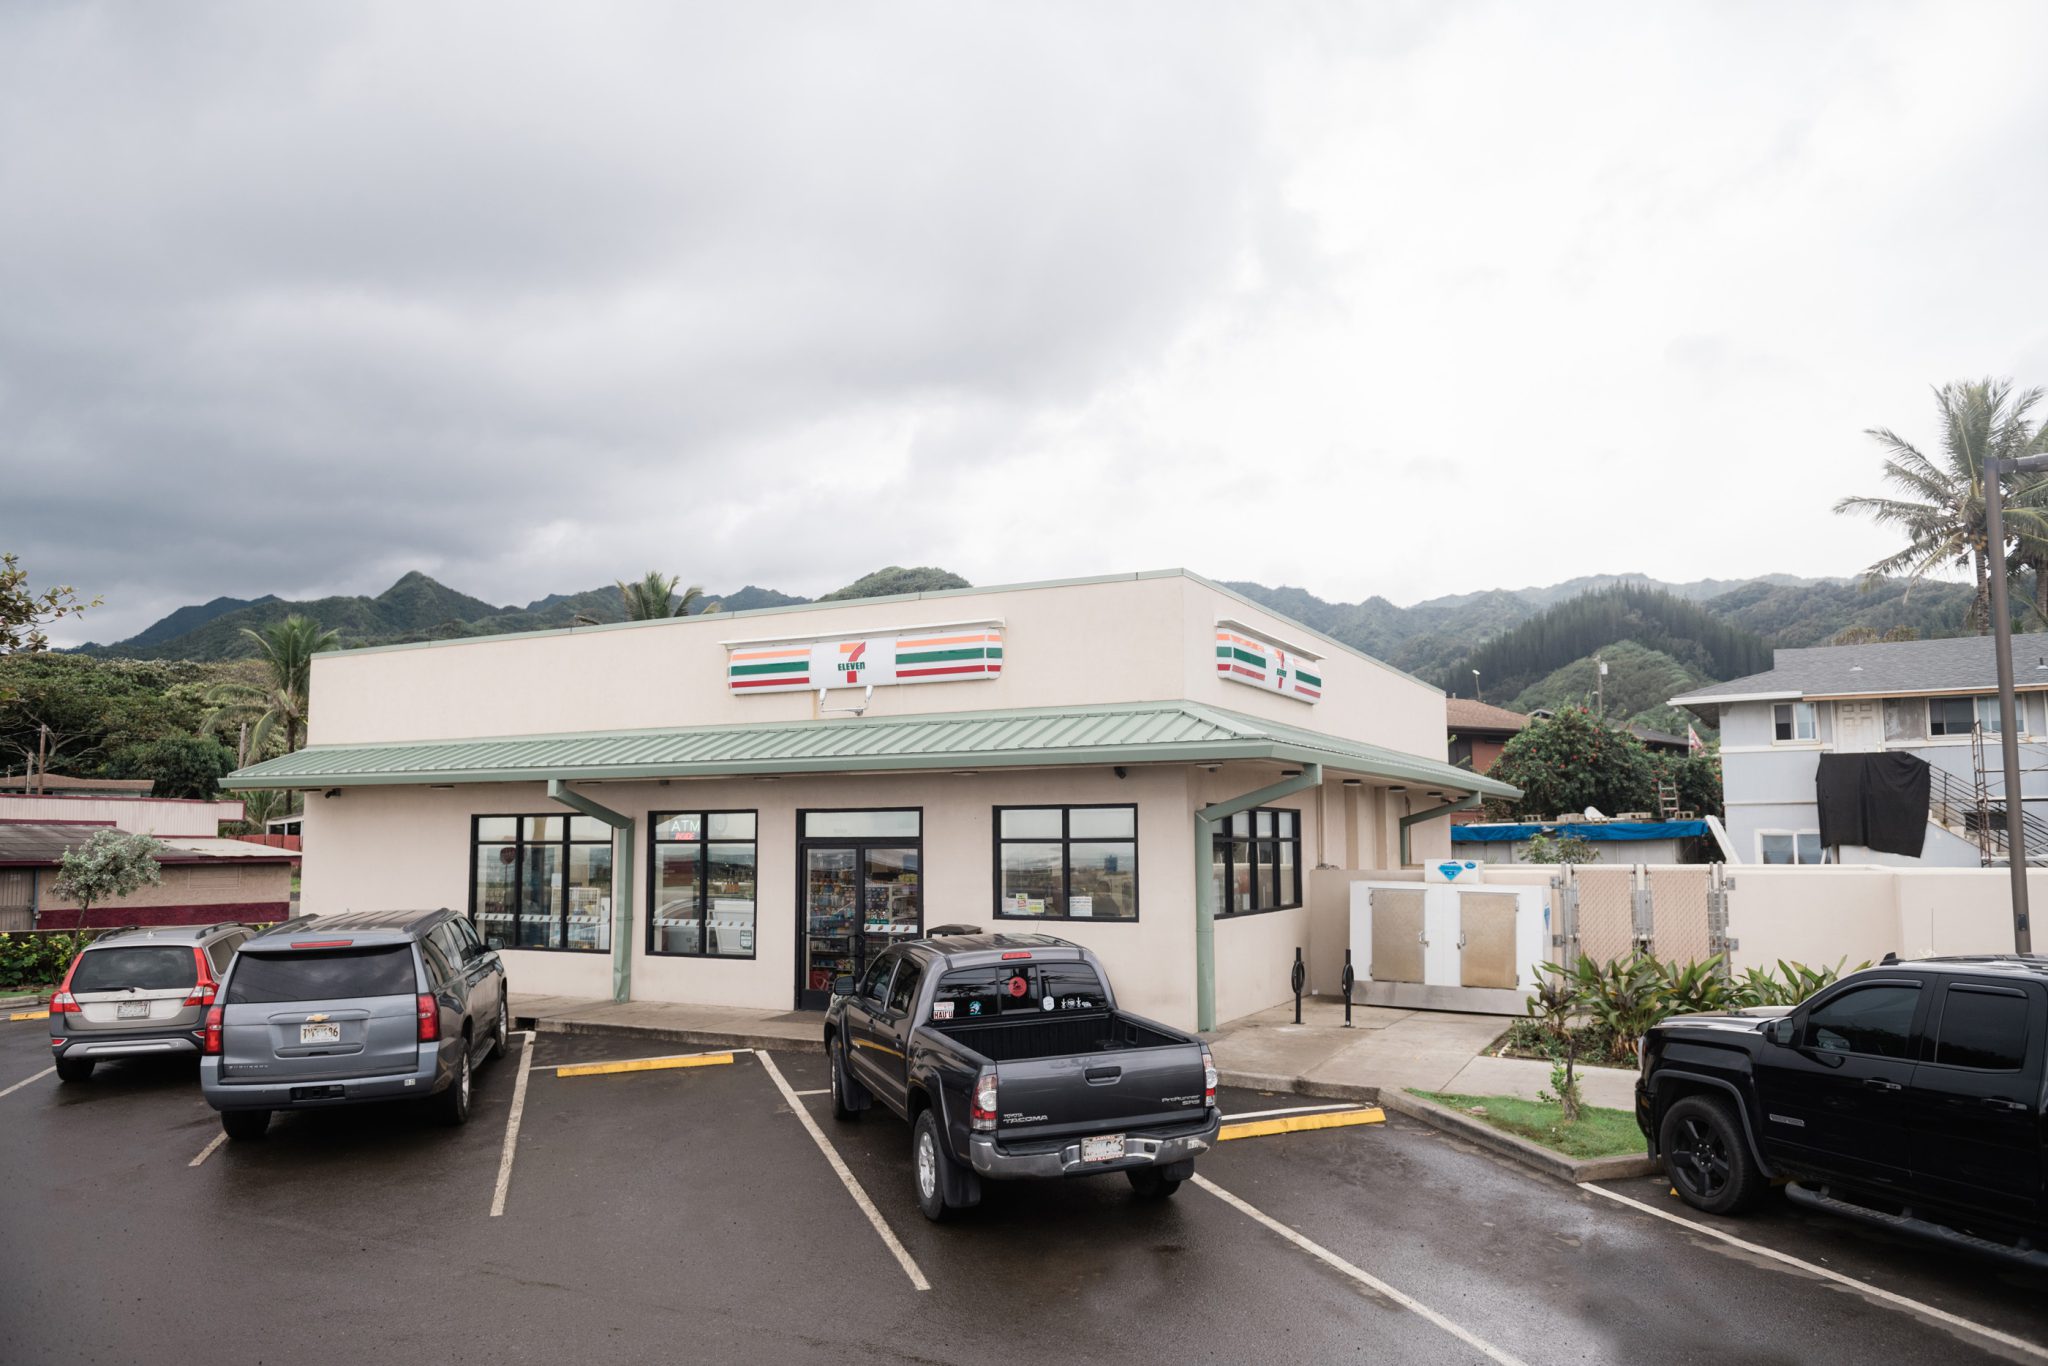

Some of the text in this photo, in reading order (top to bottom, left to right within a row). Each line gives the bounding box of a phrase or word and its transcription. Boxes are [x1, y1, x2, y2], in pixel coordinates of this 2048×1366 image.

[839, 641, 866, 684] 7
[671, 819, 701, 832] ATM
[1002, 1114, 1049, 1124] TACOMA
